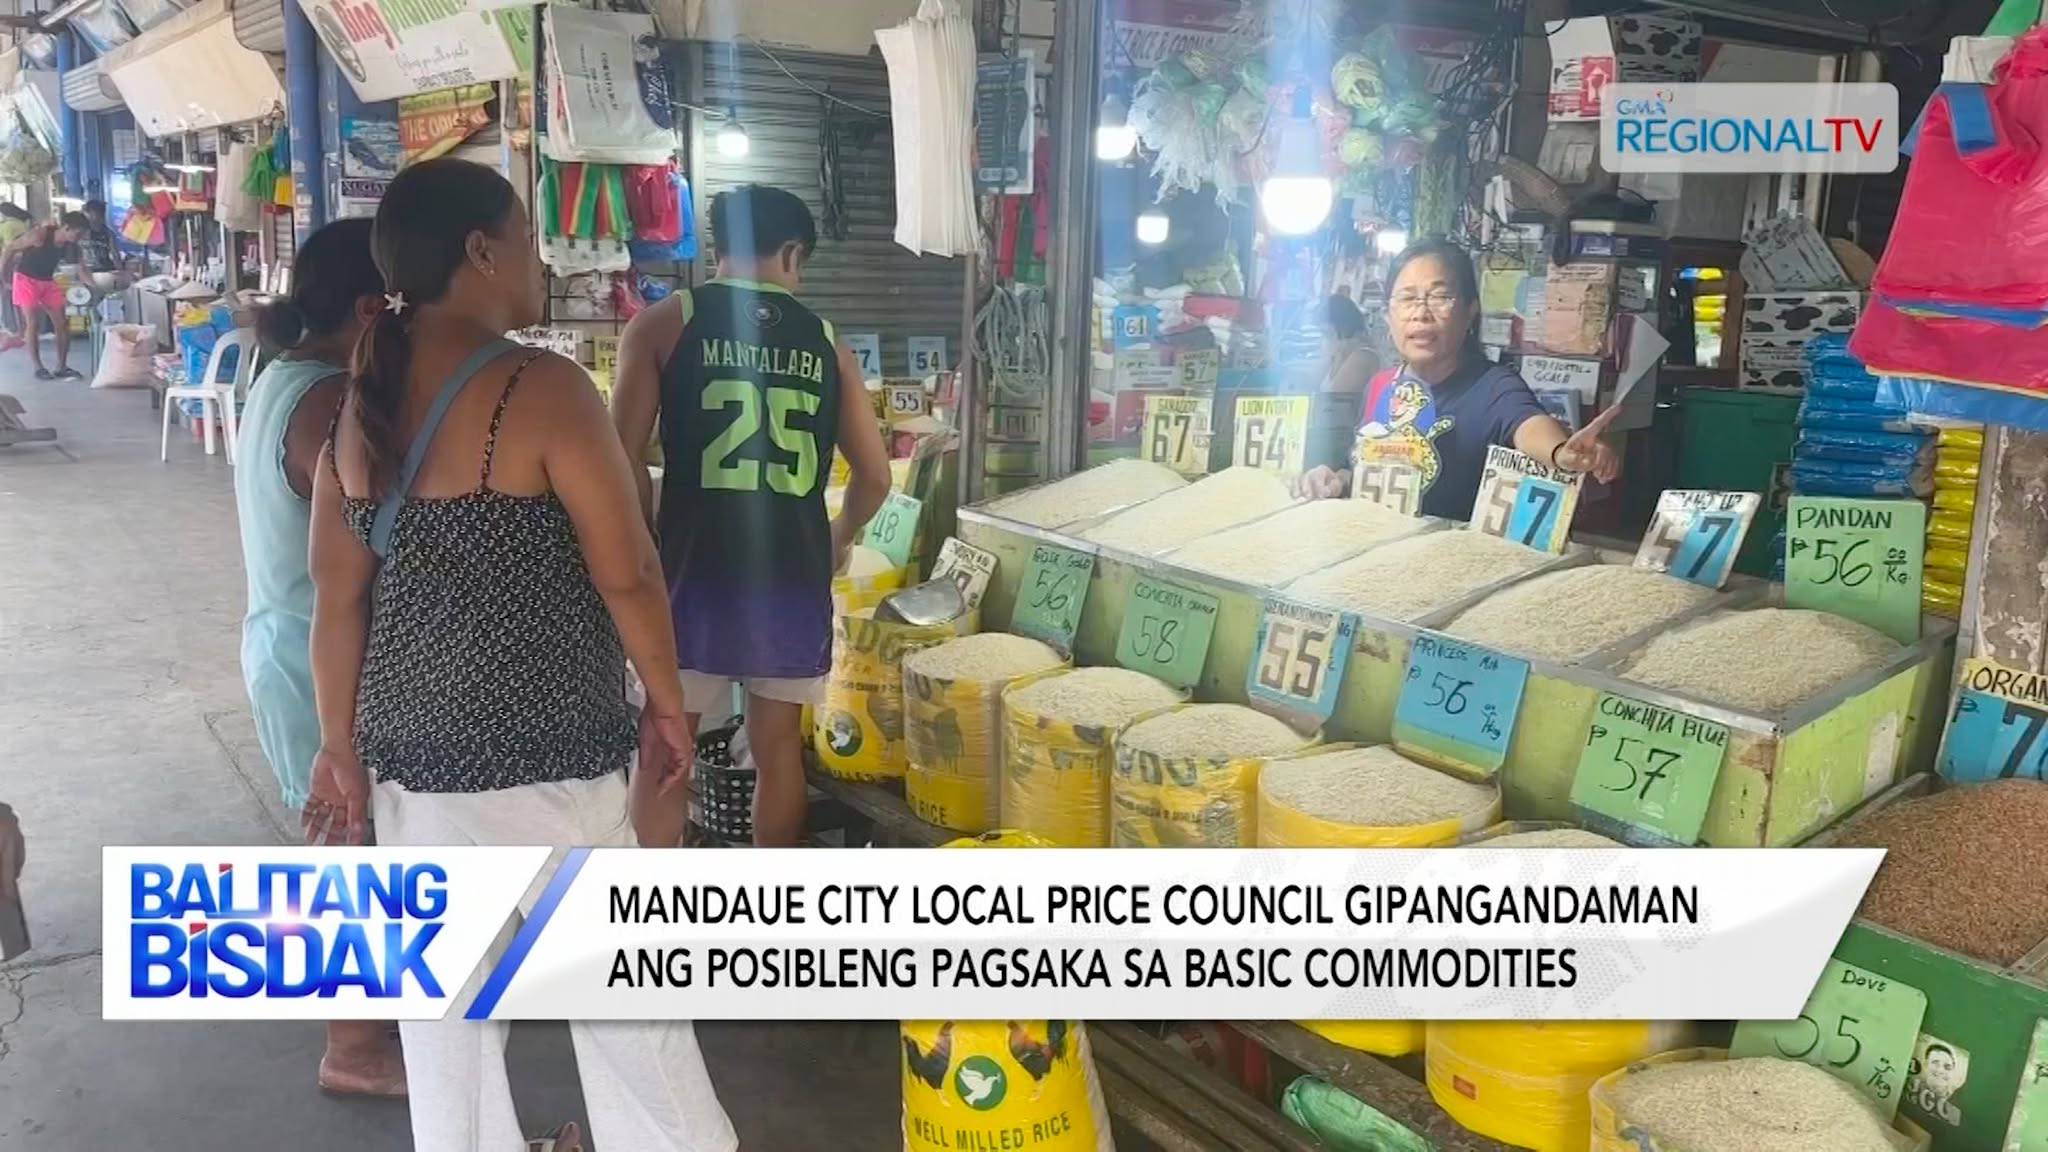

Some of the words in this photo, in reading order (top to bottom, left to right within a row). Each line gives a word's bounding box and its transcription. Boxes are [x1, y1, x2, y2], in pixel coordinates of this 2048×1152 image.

[702, 337, 823, 384] MANTALABA
[916, 351, 940, 371] 54
[895, 391, 920, 412] 55
[701, 379, 822, 498] 25
[1152, 414, 1191, 463] 67
[1244, 418, 1286, 469] 64
[1489, 448, 1549, 479] PRINCESS
[872, 511, 900, 544] 48
[1482, 478, 1557, 548] 57
[1797, 506, 1892, 529] PANDAN
[1809, 539, 1873, 588] 56
[1030, 569, 1069, 611] 56
[1131, 615, 1179, 664] 58
[1260, 621, 1326, 698] 55
[1423, 671, 1475, 715] 56
[1601, 696, 1677, 734] CONCHITA
[1681, 718, 1727, 747] BLUE
[1599, 737, 1683, 800] 57
[956, 1127, 1025, 1152] MILLED
[1033, 1110, 1071, 1144] RICE
